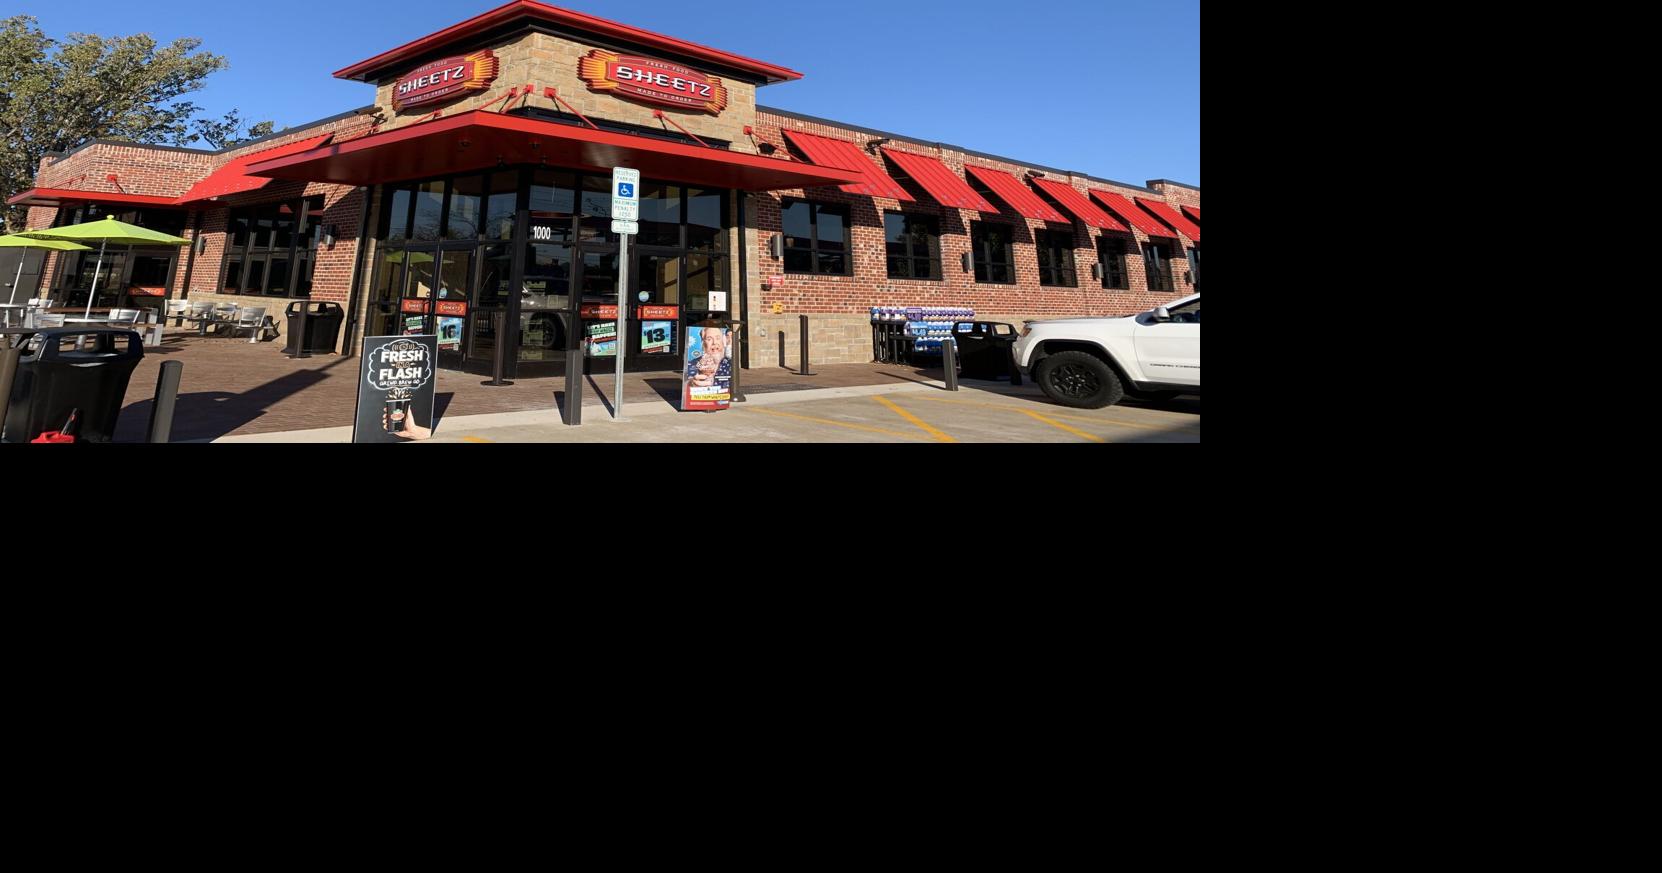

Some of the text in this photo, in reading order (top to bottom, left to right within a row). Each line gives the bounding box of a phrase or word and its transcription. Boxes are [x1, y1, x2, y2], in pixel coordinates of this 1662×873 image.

[672, 66, 689, 74] FOOD
[398, 65, 465, 96] SHEETZ
[616, 65, 711, 97] SHEETZ
[637, 87, 657, 96] MADE
[533, 225, 551, 240] 1000
[381, 350, 423, 363] FRESH
[379, 366, 422, 380] FLASH
